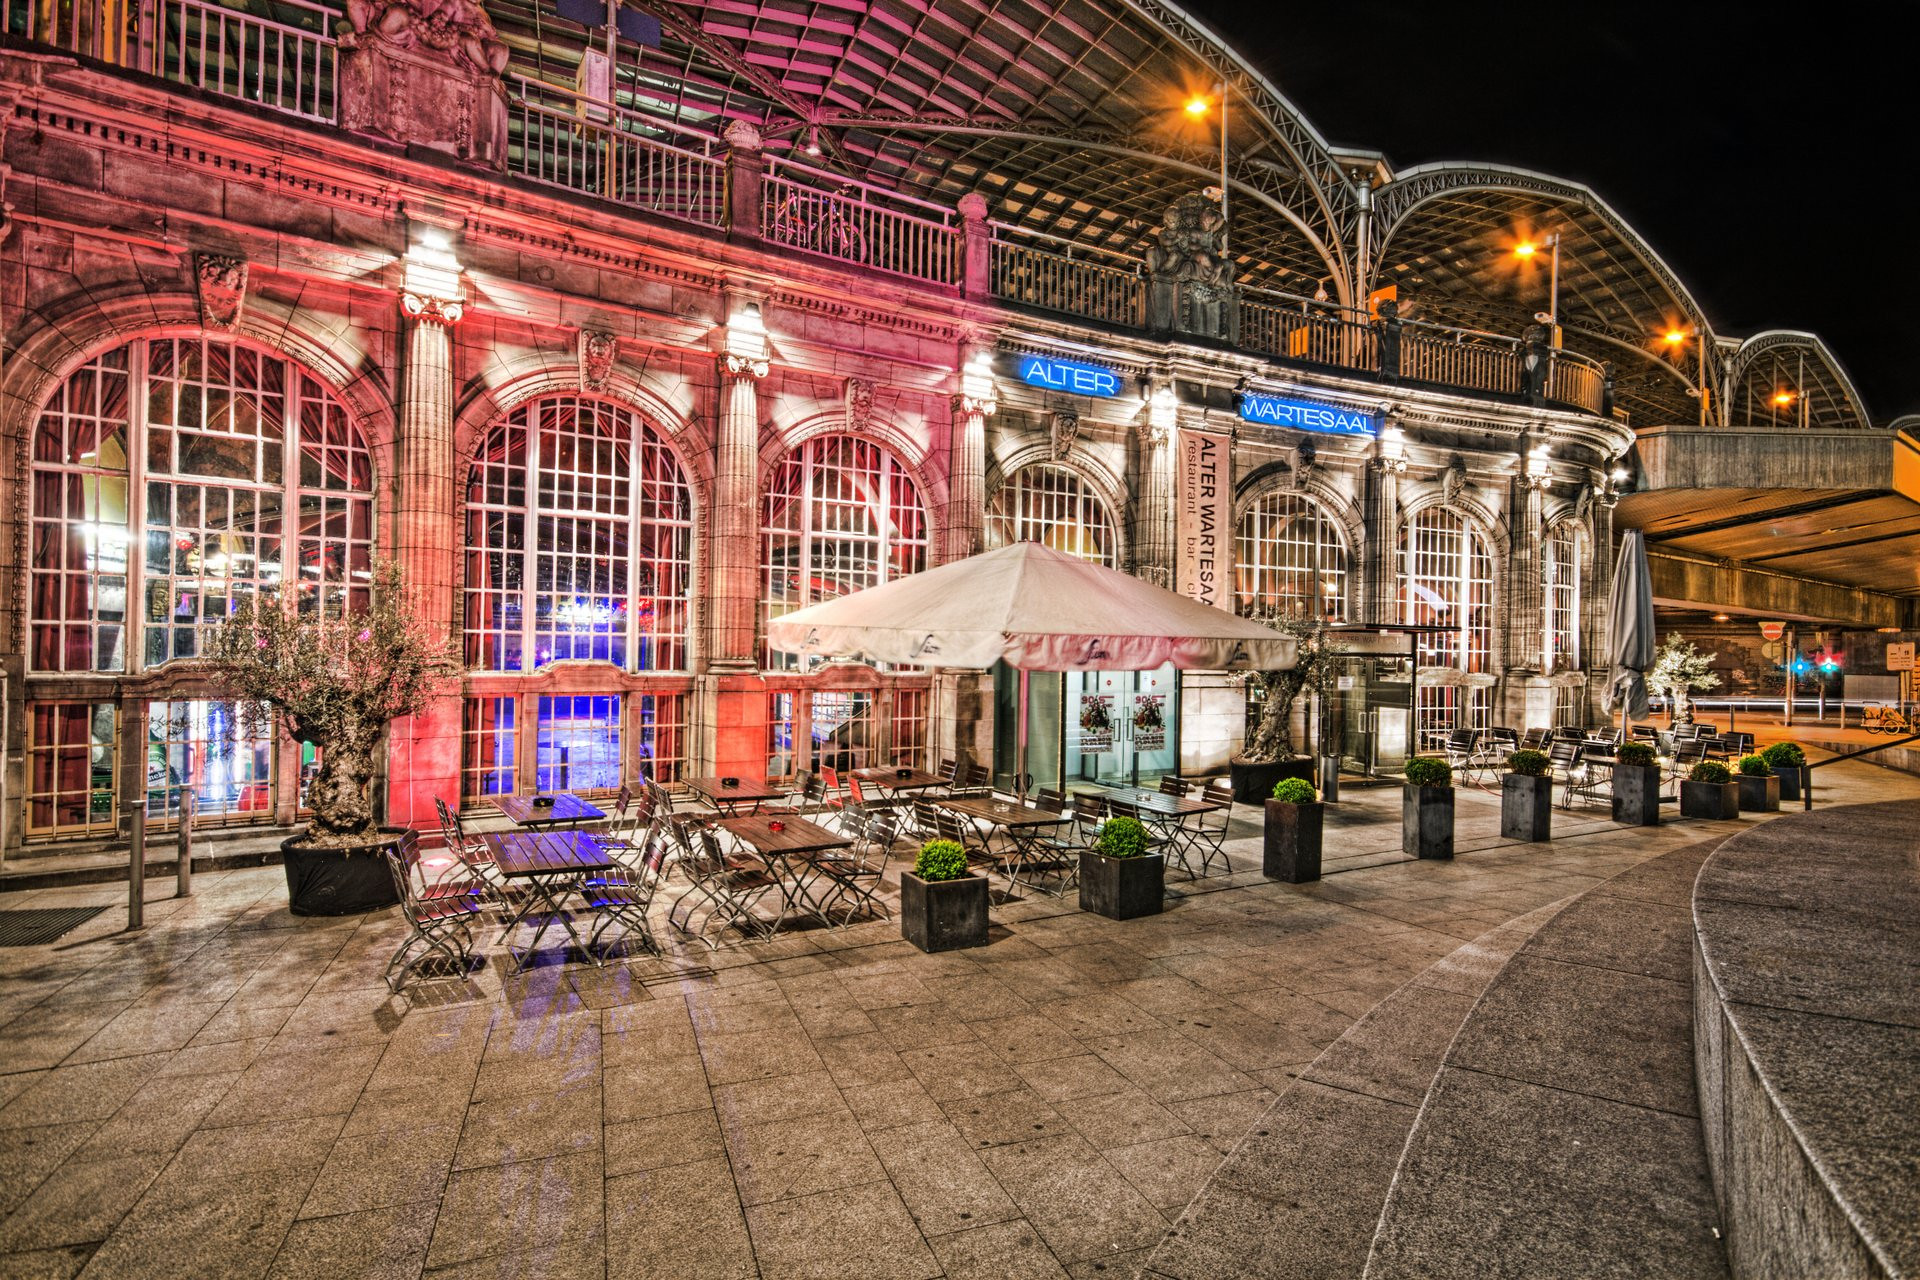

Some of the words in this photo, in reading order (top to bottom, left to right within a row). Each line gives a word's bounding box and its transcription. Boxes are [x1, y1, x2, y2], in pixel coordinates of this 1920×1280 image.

[1026, 360, 1116, 395] ALTER
[1243, 399, 1377, 435] WARTESAAL
[1187, 440, 1198, 514] restaurant
[1200, 437, 1216, 498] ALTER
[1186, 537, 1197, 561] bar
